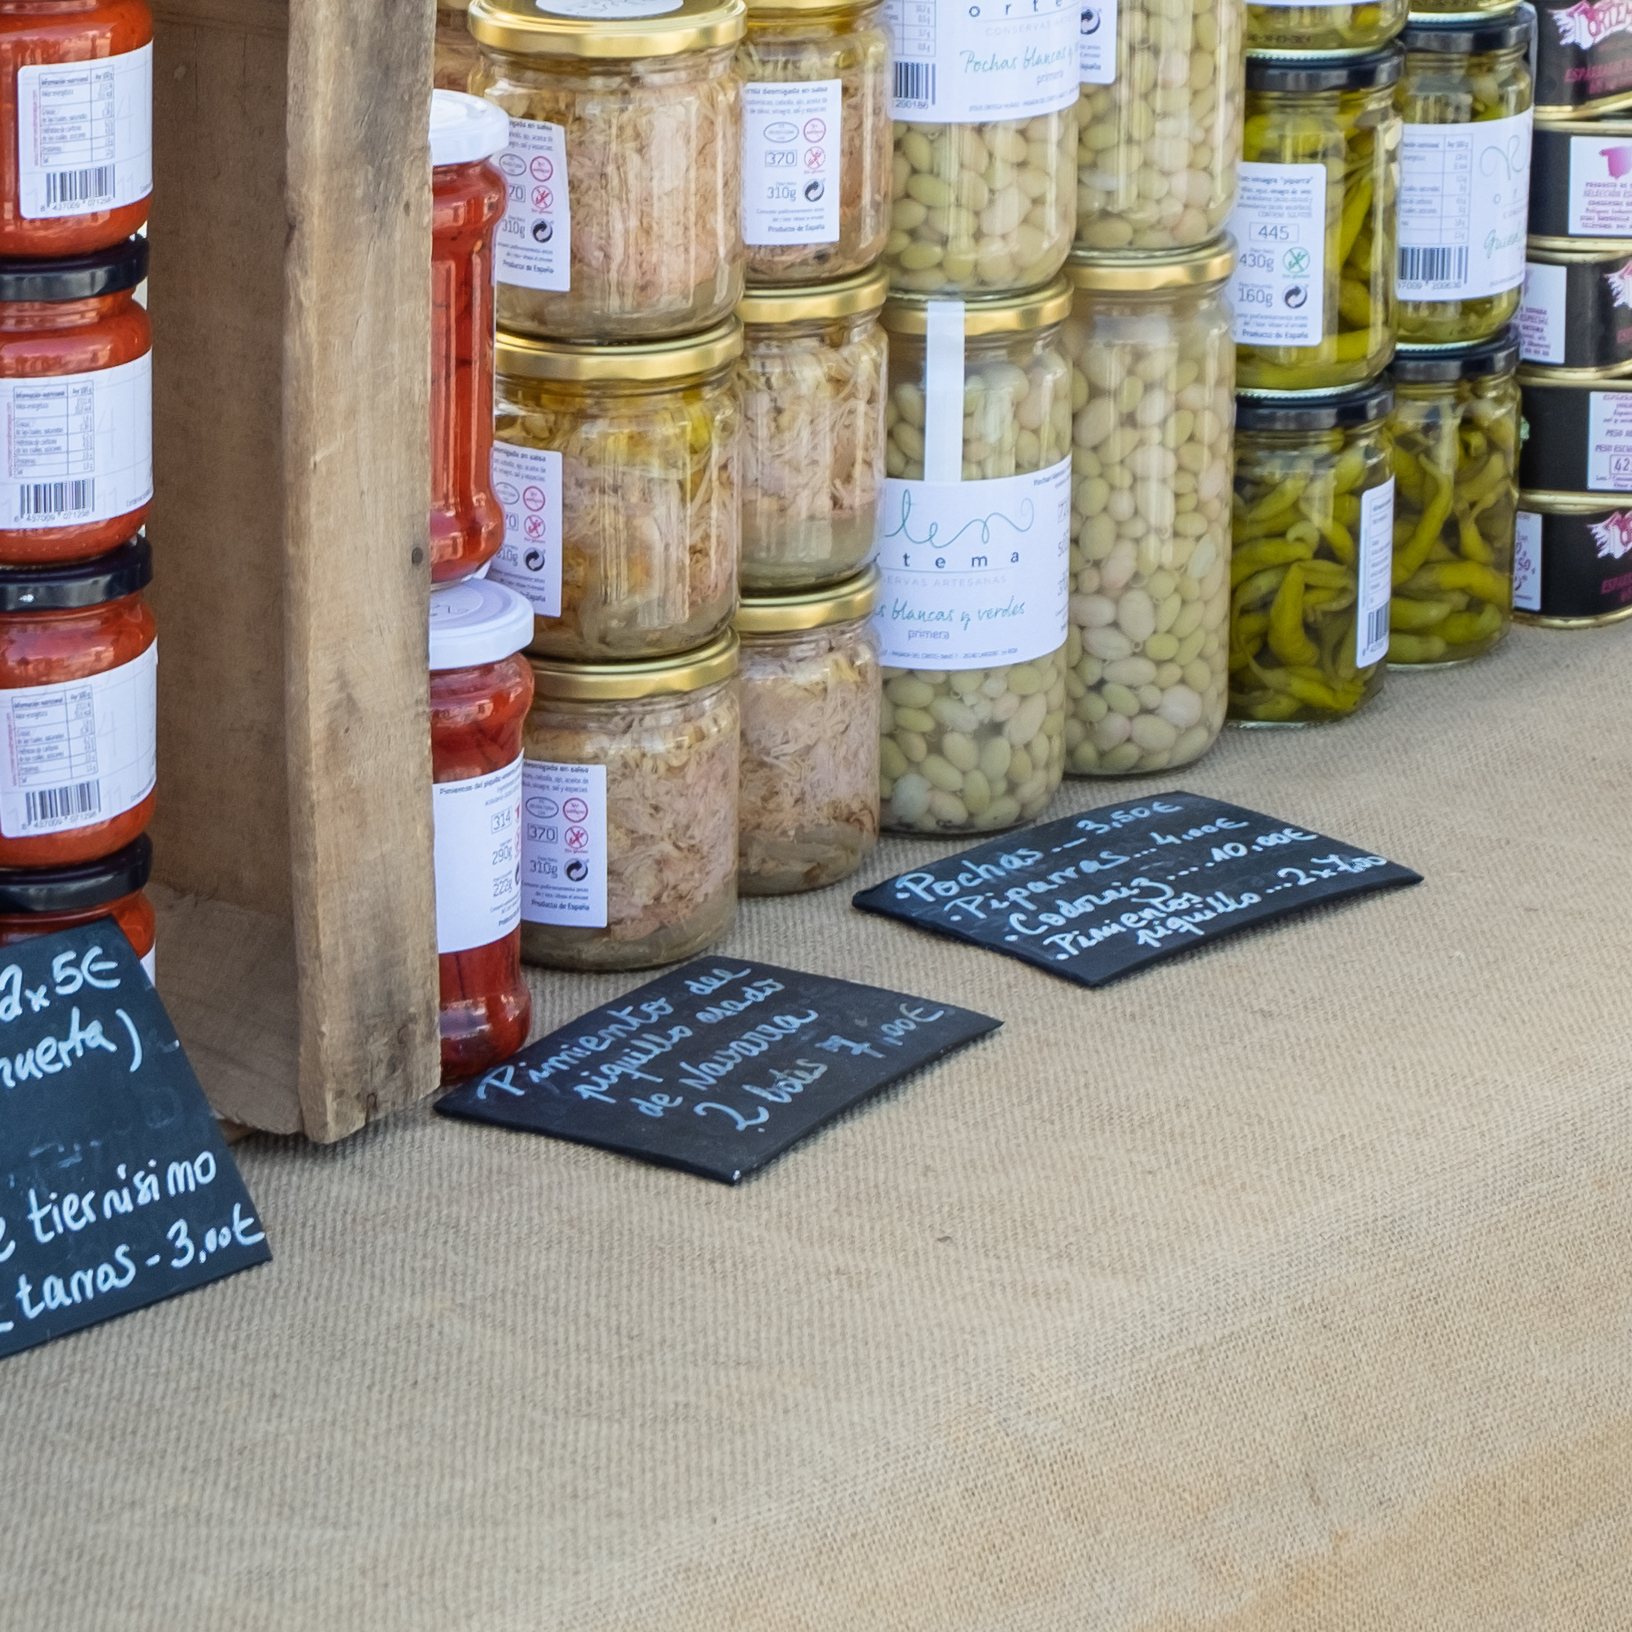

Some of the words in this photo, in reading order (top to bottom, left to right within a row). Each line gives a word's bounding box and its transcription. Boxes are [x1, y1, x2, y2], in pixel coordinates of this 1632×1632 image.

[960, 49, 1017, 74] Pochas
[768, 152, 794, 164] 370
[767, 186, 796, 201] 310g
[1258, 225, 1289, 240] 445
[1239, 254, 1274, 272] 430g
[1238, 288, 1273, 307] 160g
[892, 598, 955, 622] blancas
[978, 595, 1026, 619] verdes
[493, 810, 511, 830] 314
[529, 827, 555, 840] 370
[530, 861, 558, 878] 310g
[898, 845, 1045, 902] Pochas
[477, 995, 674, 1100] Pimiento
[574, 1022, 693, 1104] piquillo
[631, 1094, 684, 1117] de
[679, 1008, 819, 1090] Navarra
[693, 1100, 770, 1133] 2
[17, 1244, 136, 1319] tarros
